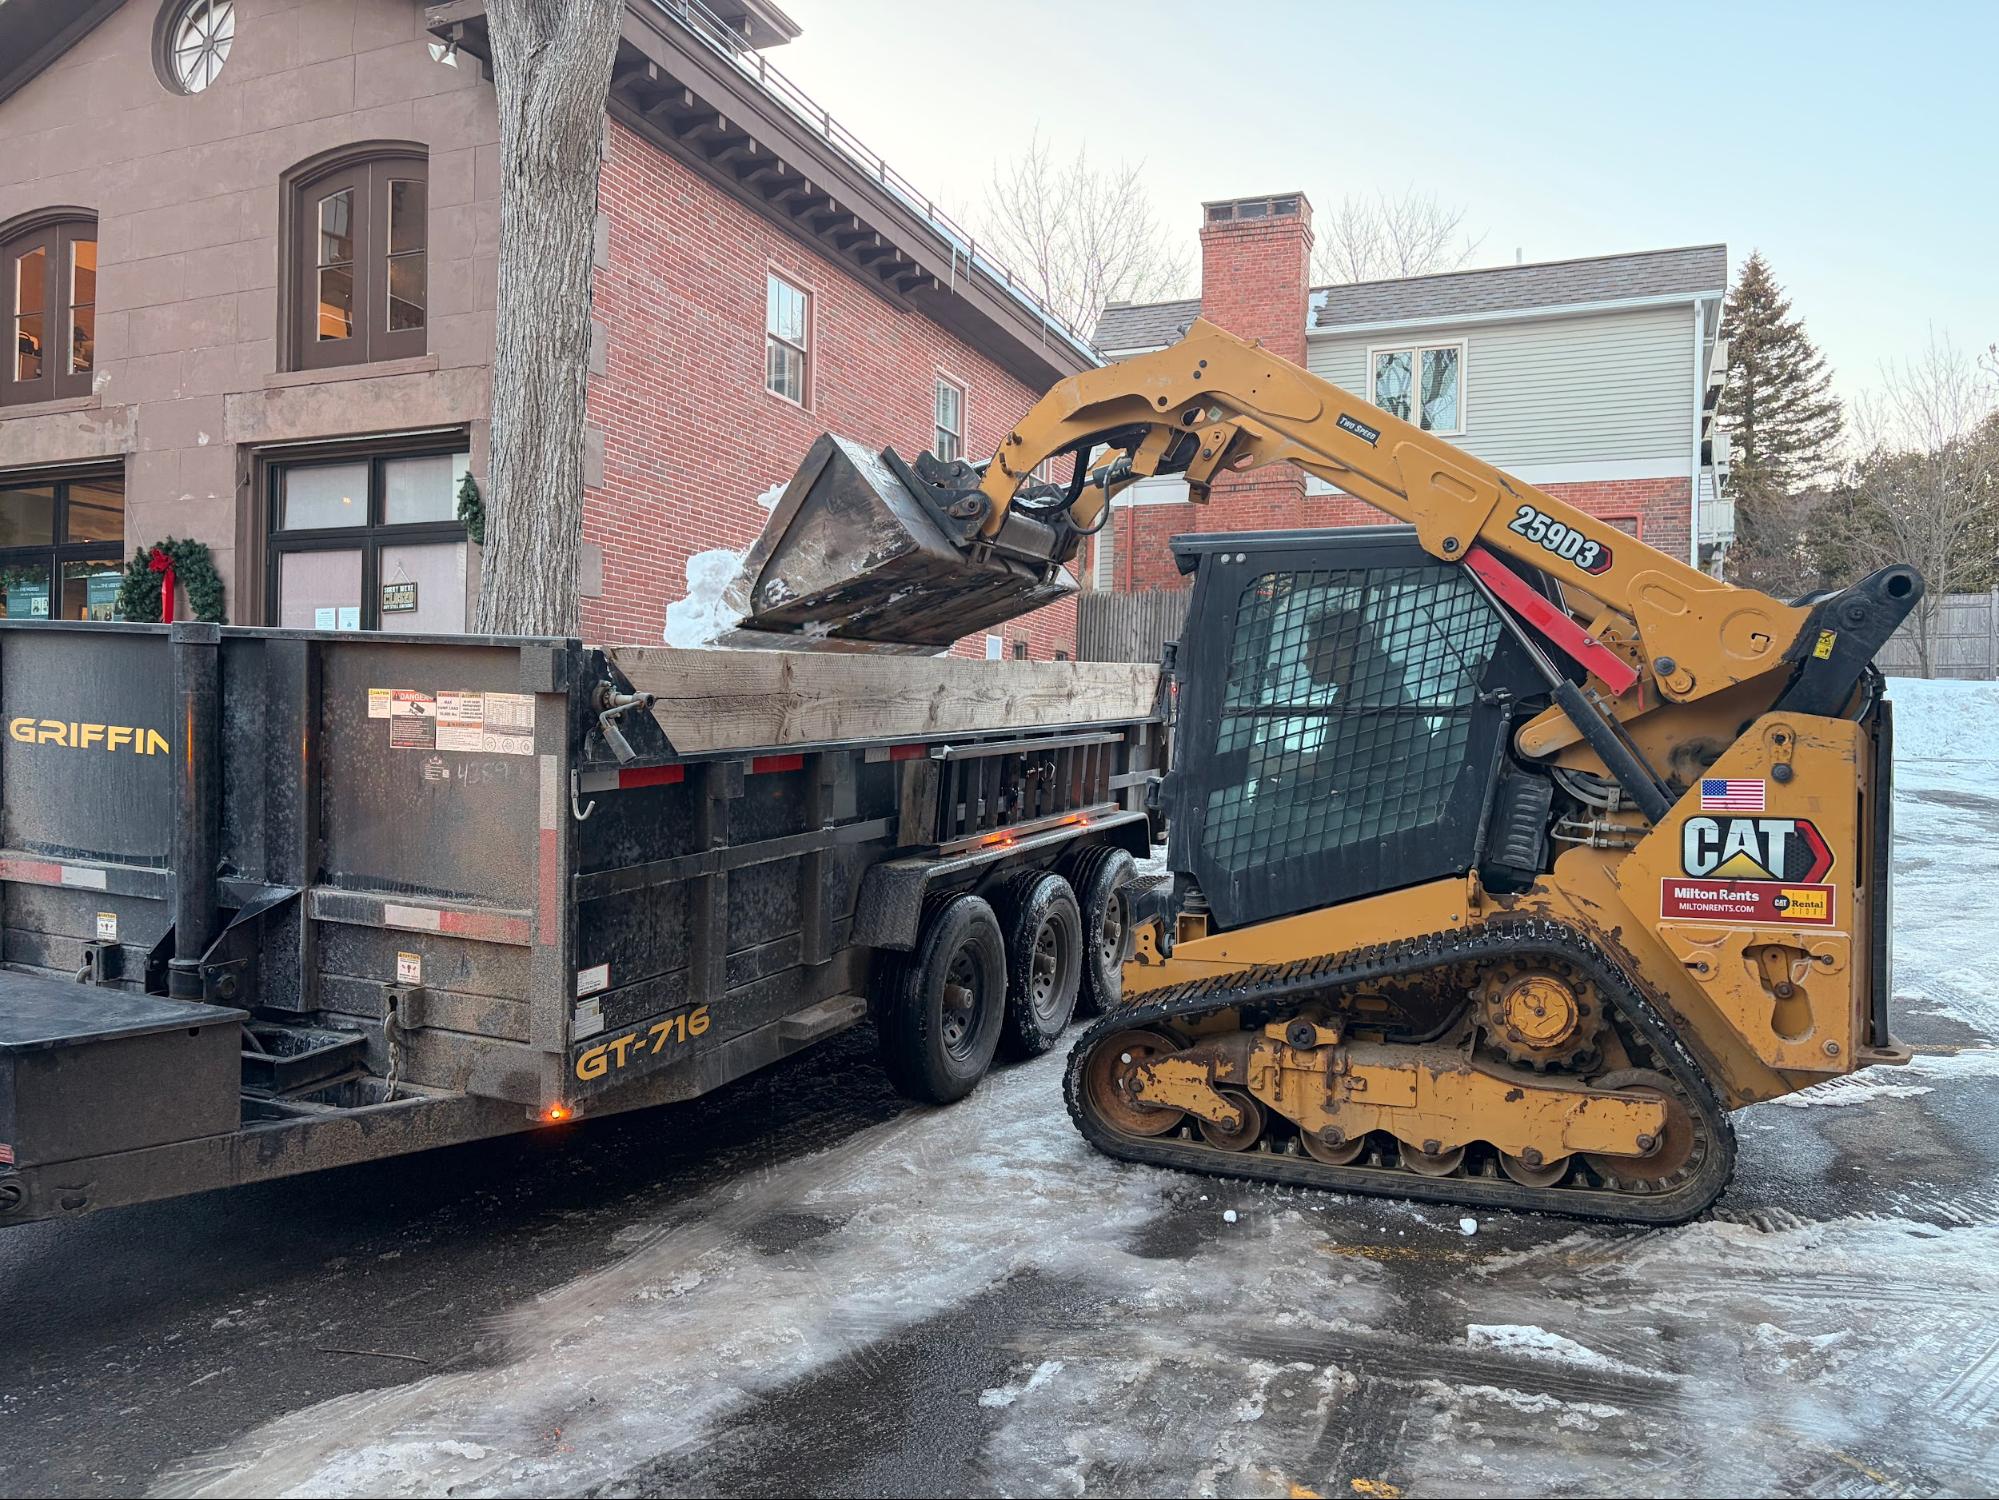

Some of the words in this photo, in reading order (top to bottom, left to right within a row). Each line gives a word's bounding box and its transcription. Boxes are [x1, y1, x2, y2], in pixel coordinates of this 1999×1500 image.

[1340, 416, 1356, 430] TWO
[1354, 424, 1377, 440] SPEED
[1508, 505, 1601, 568] 259D3
[9, 717, 170, 756] GRIFFIN
[1684, 817, 1795, 879] CAT
[1674, 887, 1718, 901] Milton
[1719, 889, 1760, 902] Rents
[1679, 902, 1755, 913] MILTONRENTS.COM
[1774, 898, 1788, 907] CAT
[1791, 899, 1824, 909] Rental
[576, 1004, 711, 1081] GT-716
